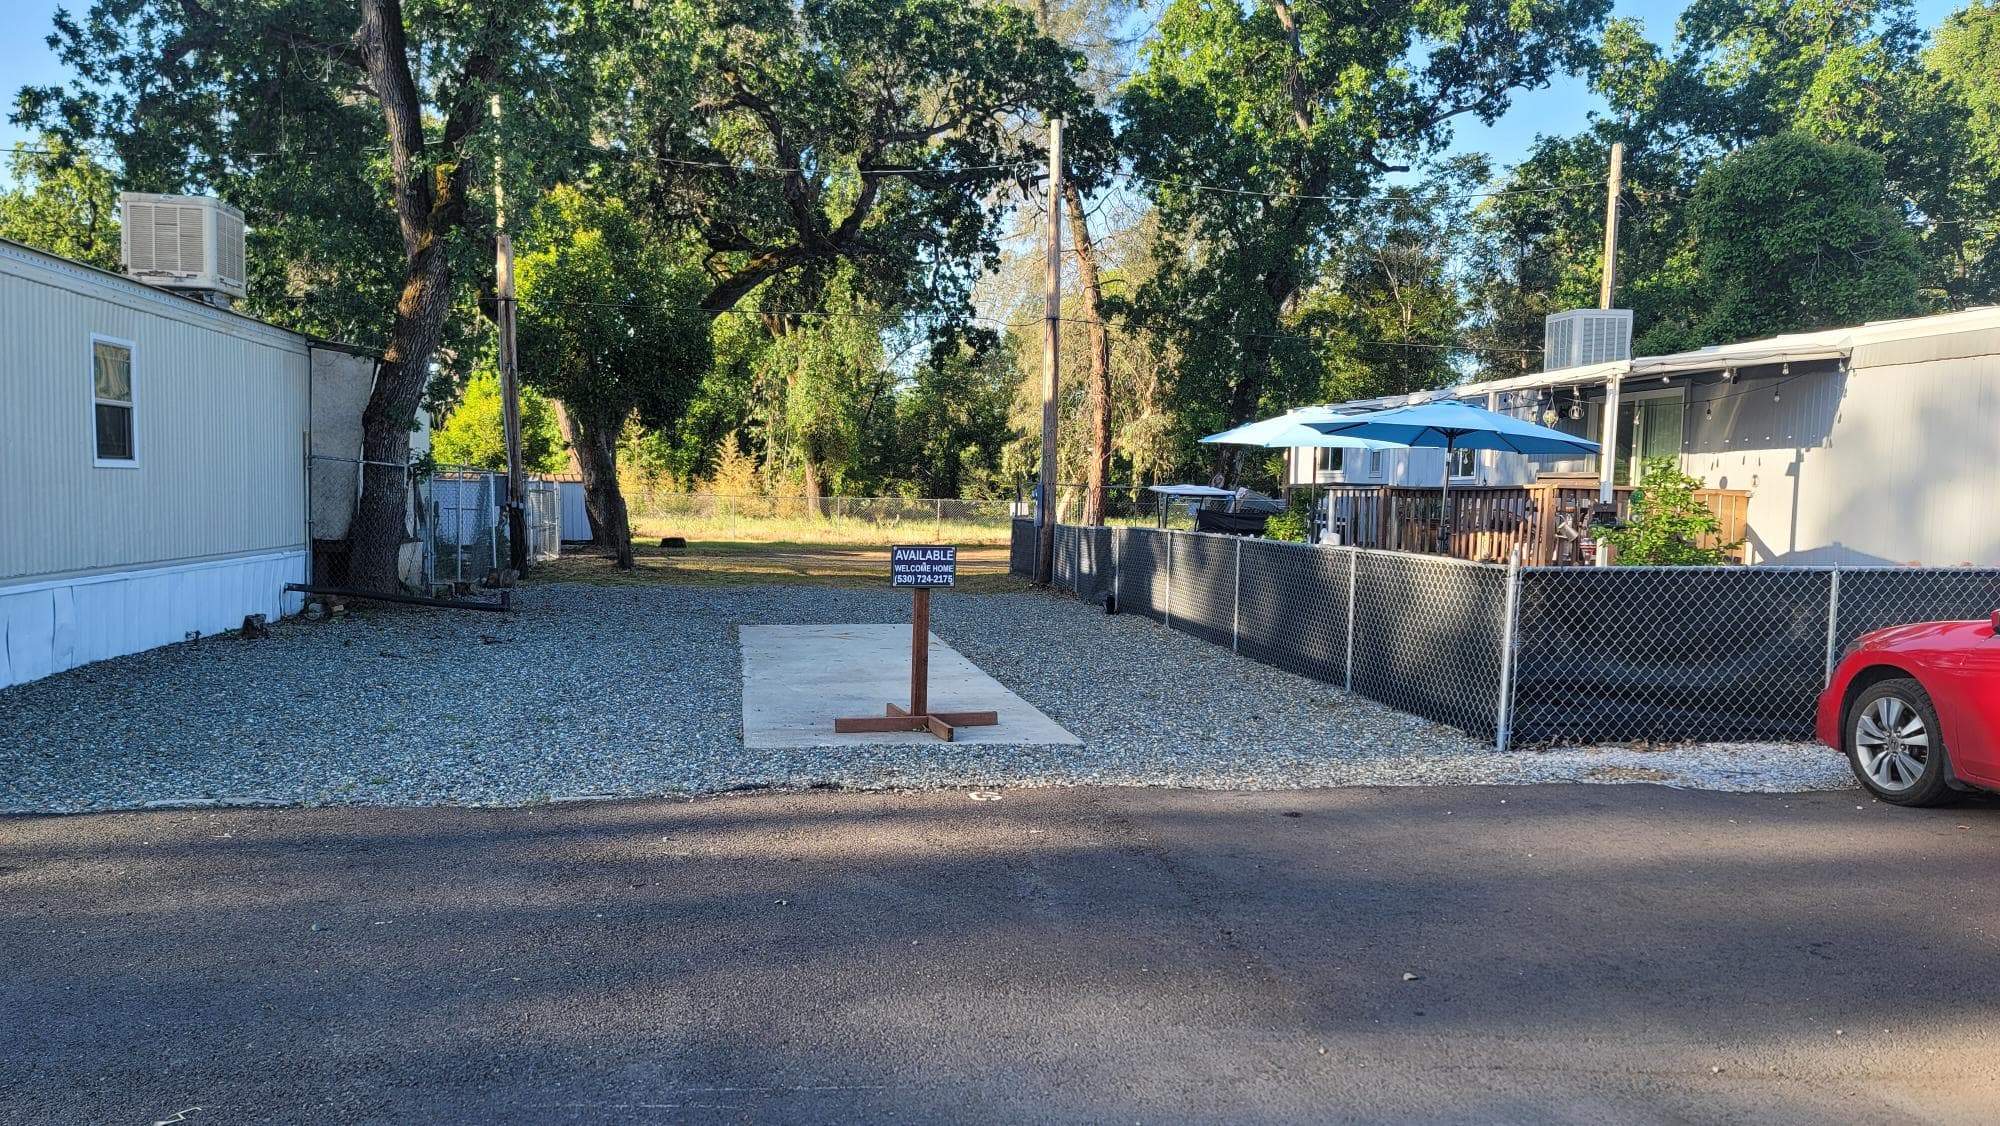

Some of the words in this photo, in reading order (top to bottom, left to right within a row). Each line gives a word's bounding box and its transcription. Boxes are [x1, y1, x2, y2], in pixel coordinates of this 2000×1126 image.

[896, 550, 953, 560] AVAILABLE
[895, 575, 915, 584] (530)
[917, 575, 952, 583] 724-2175
